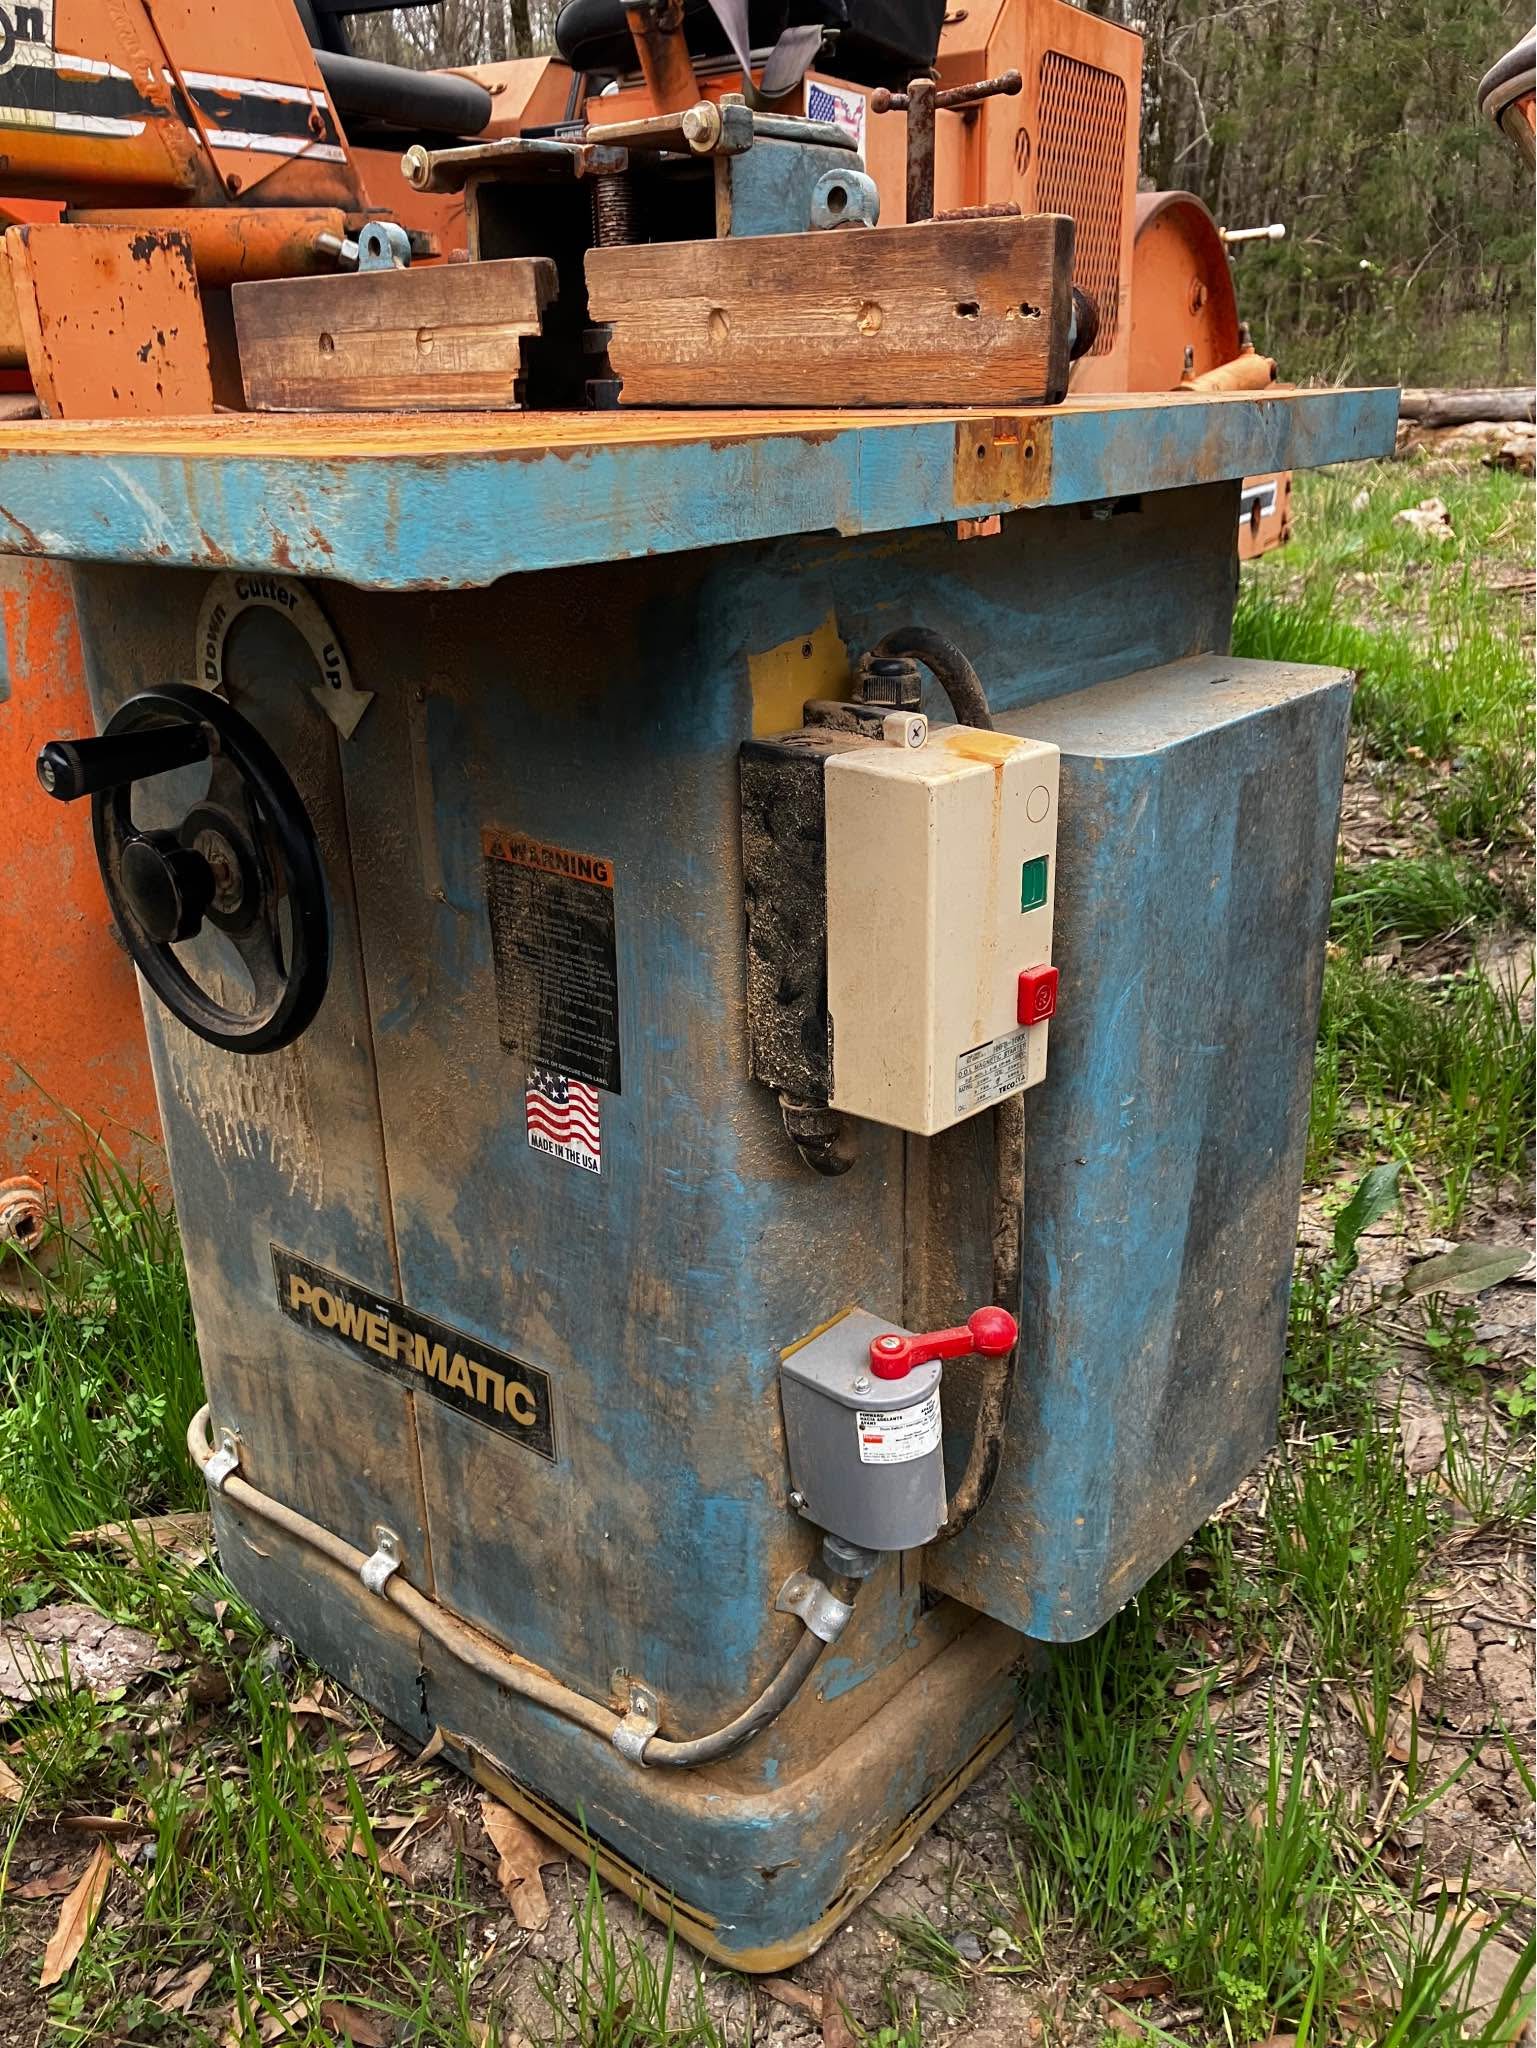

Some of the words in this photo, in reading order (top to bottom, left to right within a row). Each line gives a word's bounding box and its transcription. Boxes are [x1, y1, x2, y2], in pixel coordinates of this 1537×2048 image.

[234, 577, 298, 611] Cutter
[510, 838, 608, 882] WARNING
[593, 1075, 609, 1086] LABEL
[998, 1081, 1015, 1094] TECO
[531, 1134, 554, 1154] MADE
[555, 1143, 564, 1157] IN
[565, 1147, 581, 1164] THE
[582, 1154, 599, 1172] USA
[288, 1273, 538, 1426] POWERMATIC
